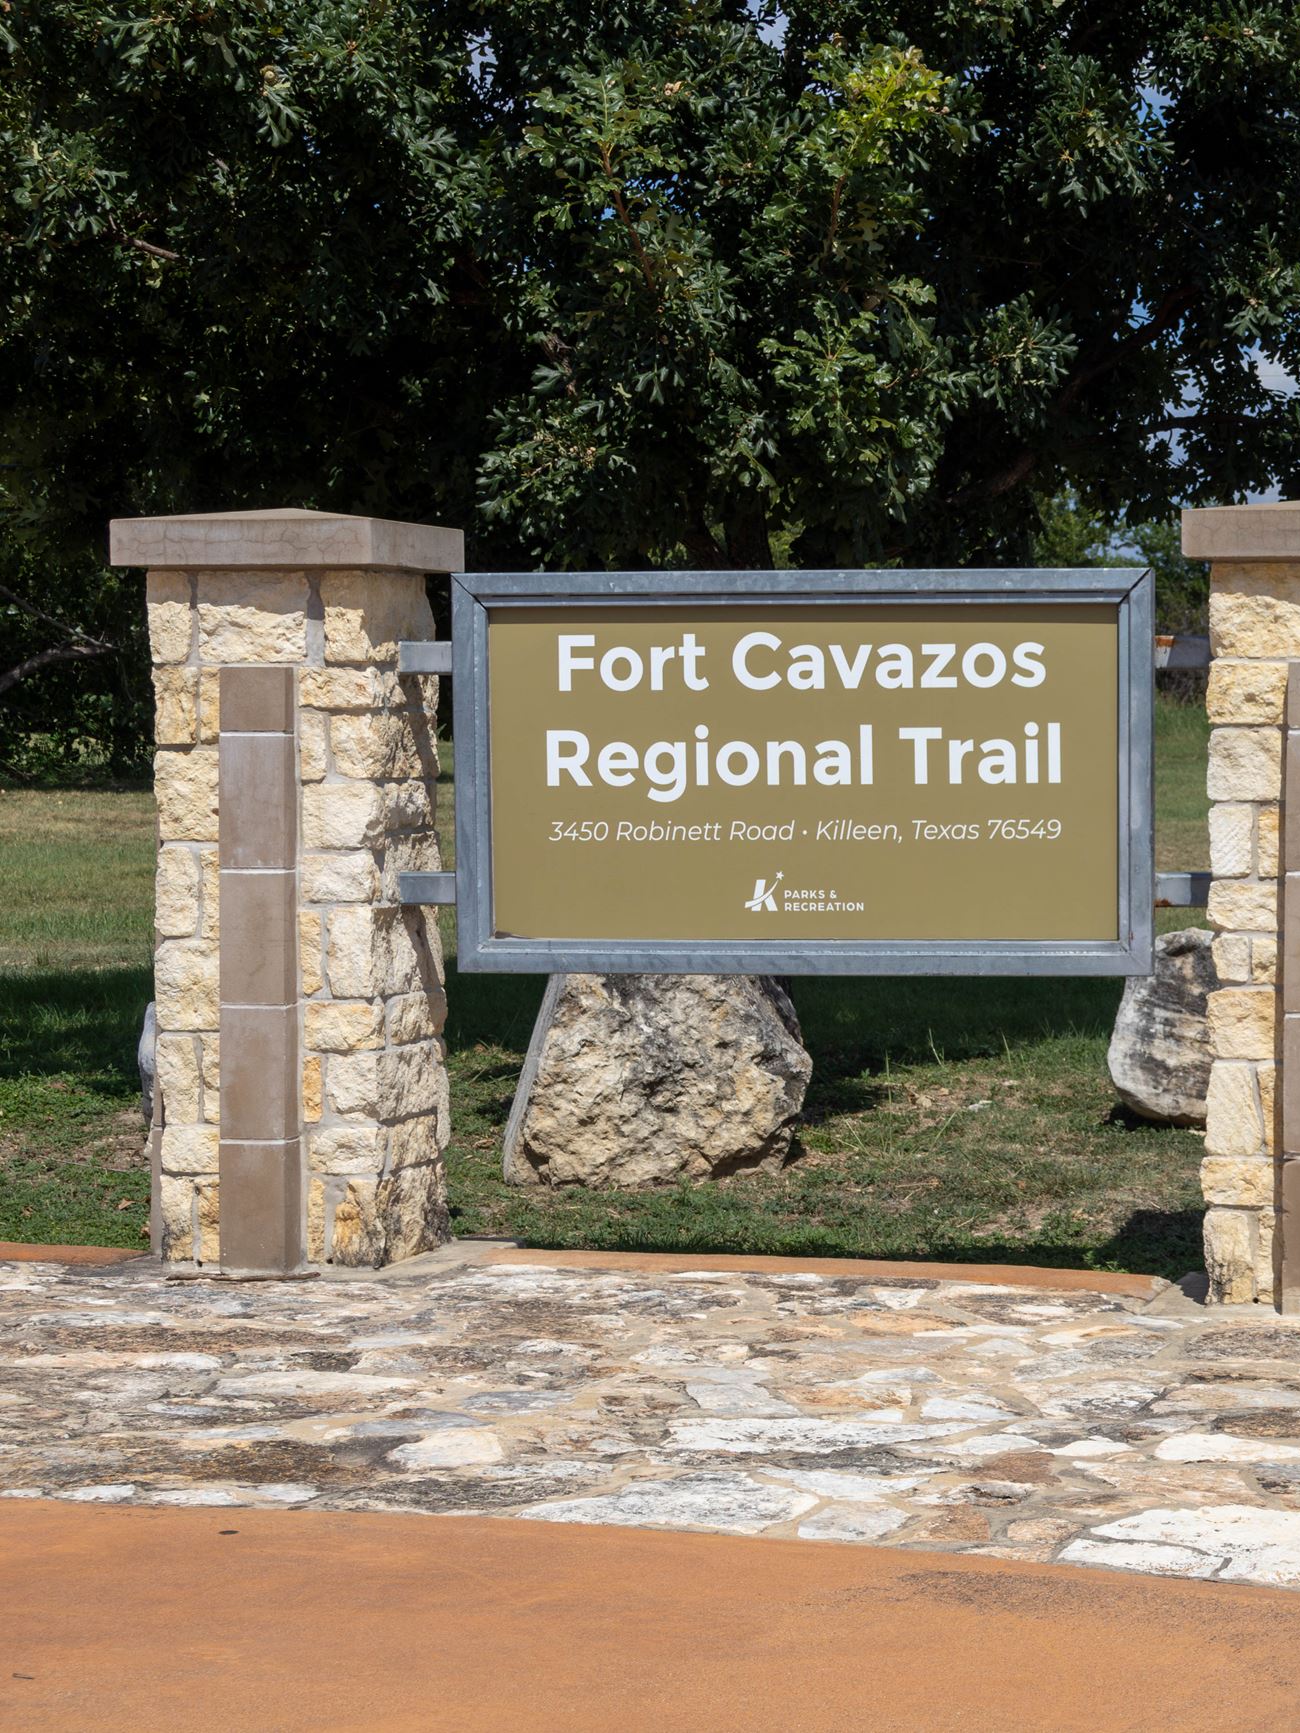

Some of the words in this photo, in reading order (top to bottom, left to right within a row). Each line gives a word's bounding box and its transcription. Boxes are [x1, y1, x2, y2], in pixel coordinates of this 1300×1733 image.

[557, 633, 710, 692] Fort
[731, 631, 1047, 691] Cavazos
[545, 723, 874, 803] Regional
[898, 721, 1062, 785] Trail
[548, 821, 609, 842] 3450
[616, 820, 722, 842] Robinett
[729, 819, 796, 841] Road
[815, 819, 903, 844] Killeen,
[911, 819, 980, 841] Texas
[987, 818, 1062, 840] 76549
[784, 889, 825, 899] PARKS
[829, 889, 837, 899] &
[784, 902, 865, 912] RECREATION
